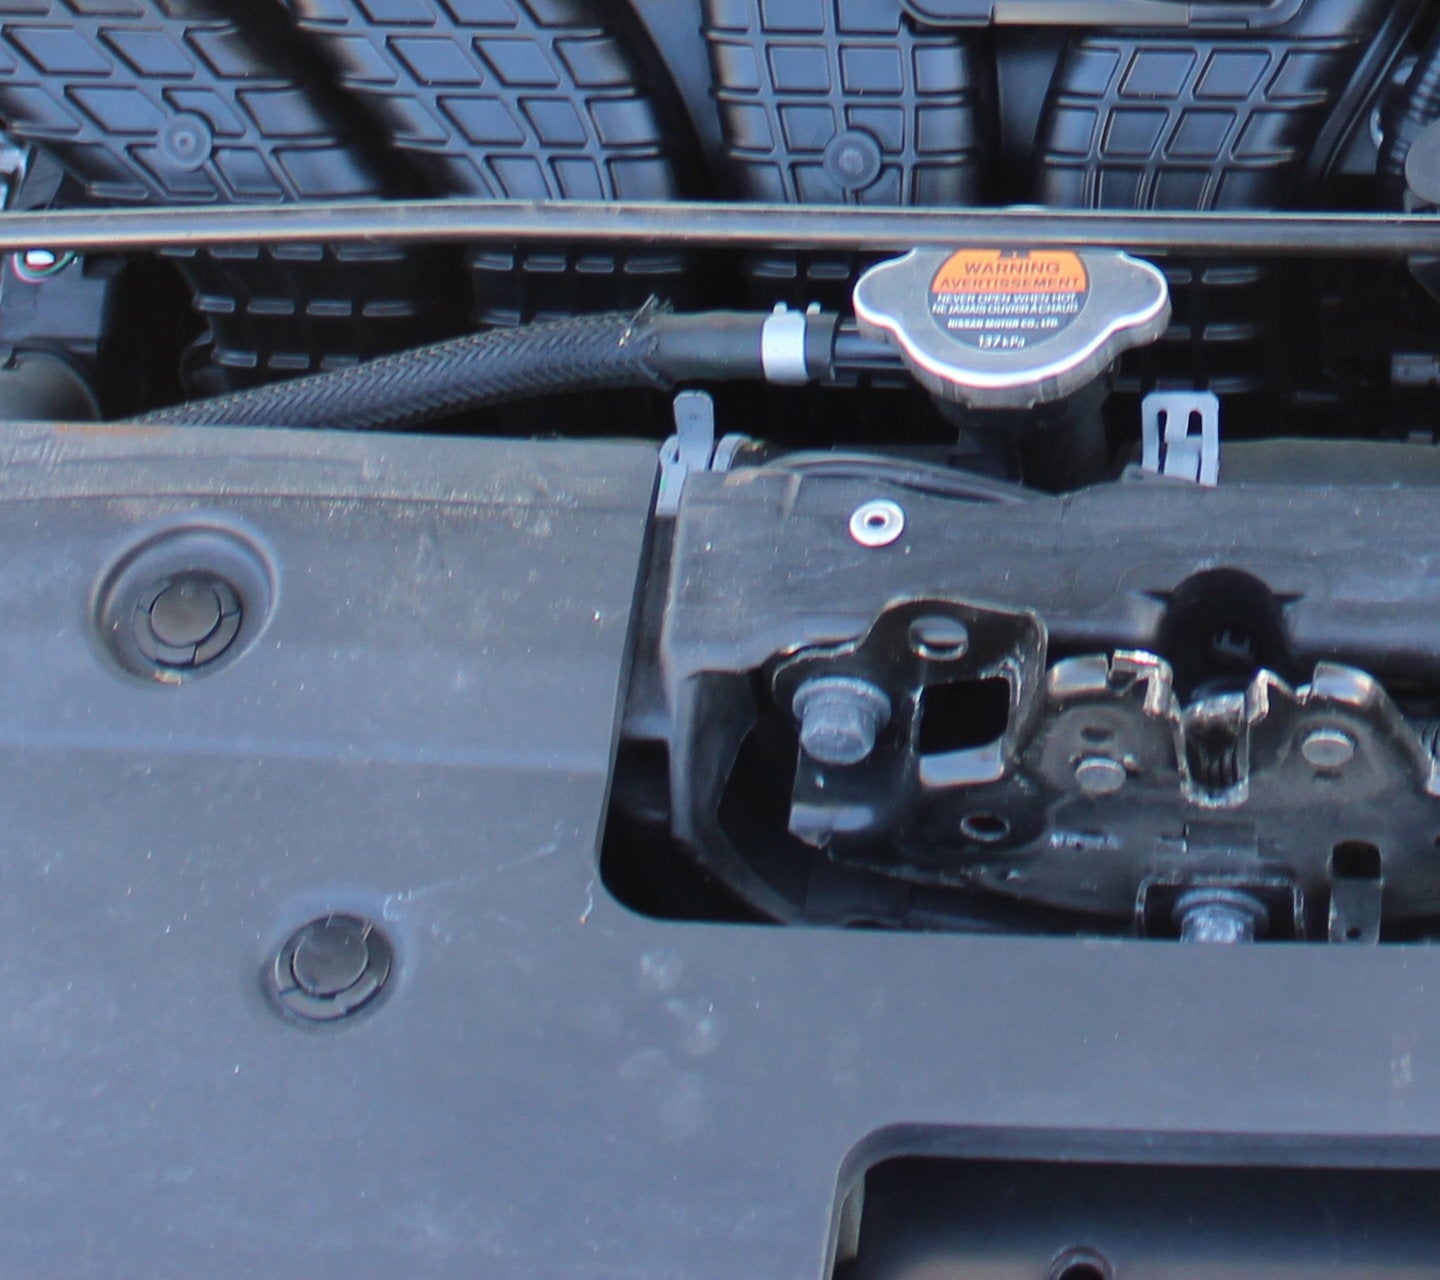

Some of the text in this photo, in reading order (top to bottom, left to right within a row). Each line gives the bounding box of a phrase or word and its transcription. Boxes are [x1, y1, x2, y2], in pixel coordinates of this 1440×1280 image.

[964, 261, 1060, 275] WARNING
[940, 277, 1080, 289] AVERTISSEMENT
[937, 293, 975, 304] NEVER
[977, 293, 1010, 304] OPEN
[1013, 293, 1049, 304] WHEN
[932, 303, 947, 314] NE
[948, 303, 986, 314] JAMAIS
[948, 318, 984, 329] NISSAN
[985, 318, 1019, 329] MOTOR
